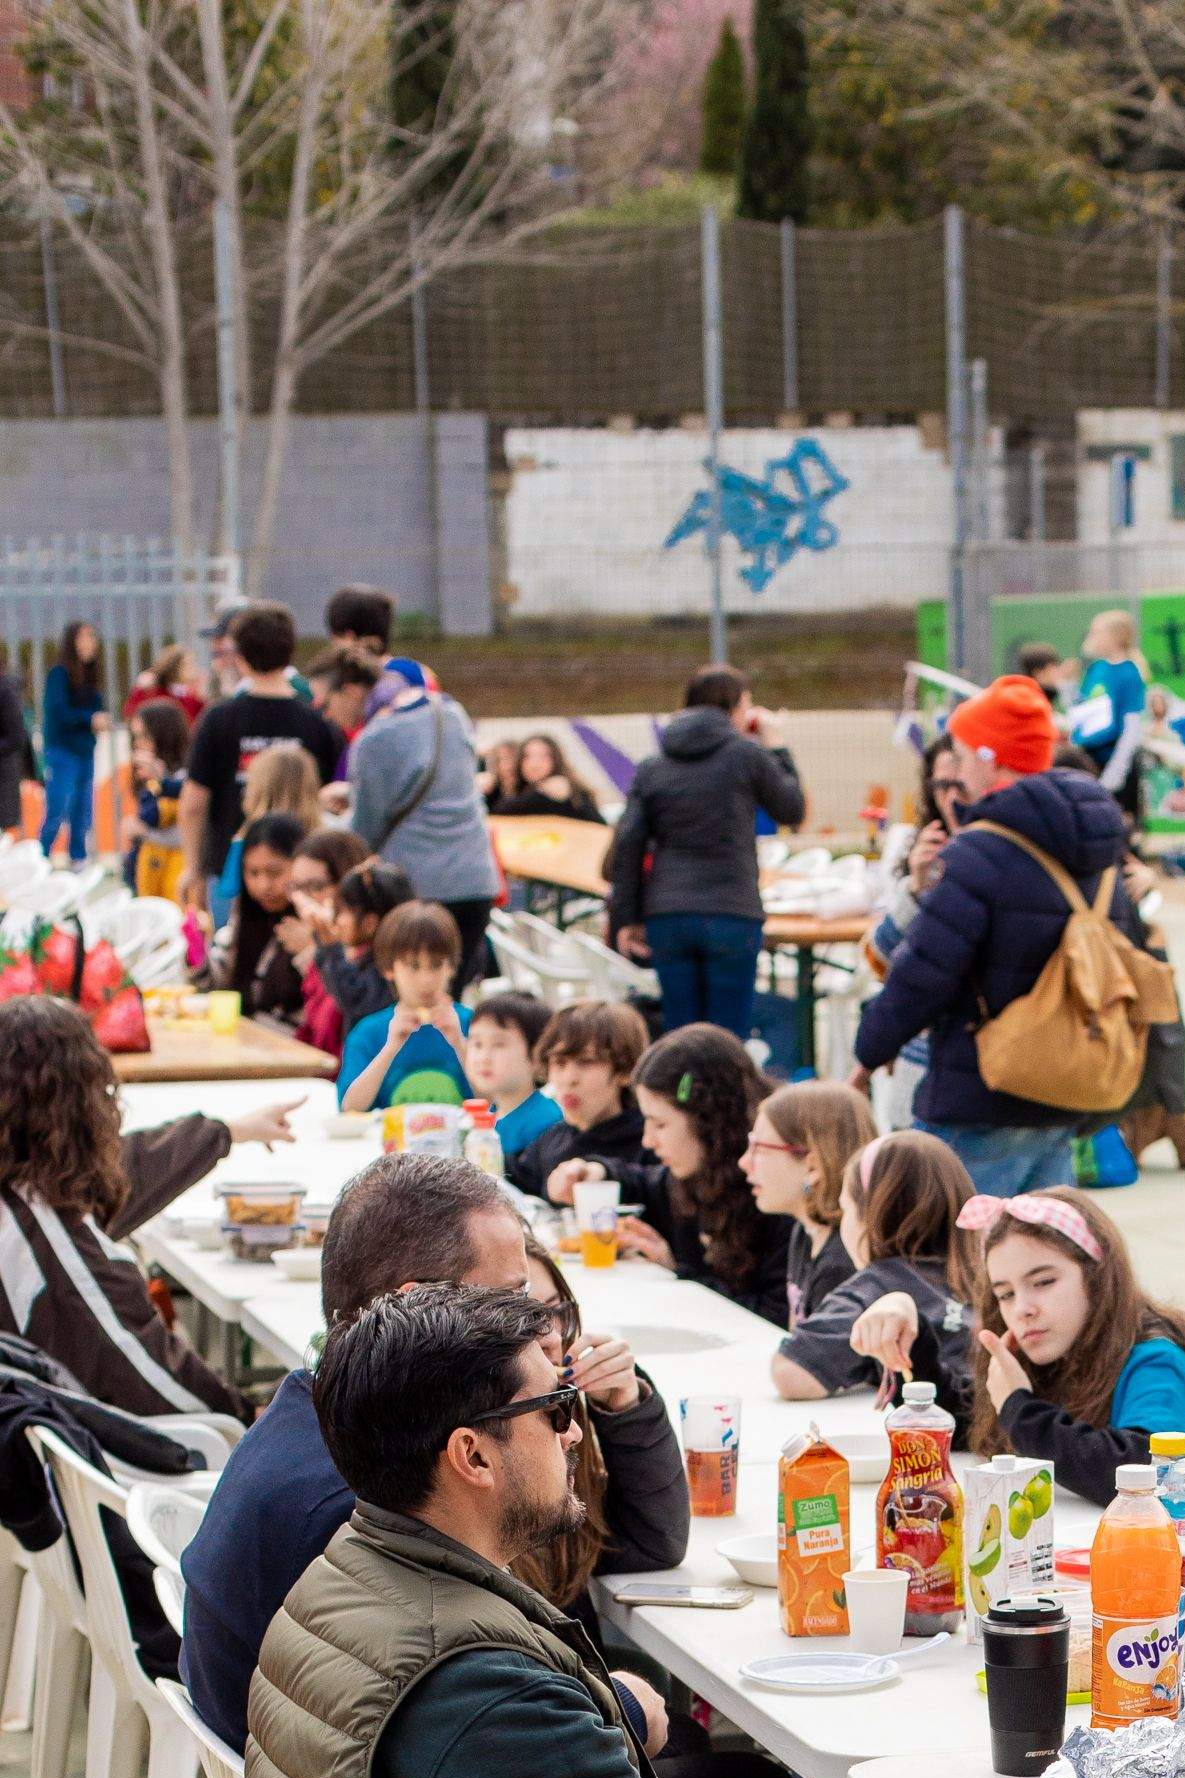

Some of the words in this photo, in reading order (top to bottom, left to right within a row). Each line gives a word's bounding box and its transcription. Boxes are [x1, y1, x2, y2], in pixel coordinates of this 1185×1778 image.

[899, 1438, 926, 1453] DON
[800, 1501, 830, 1511] Zumo
[809, 1530, 831, 1539] Pura
[804, 1537, 839, 1550] Naranja
